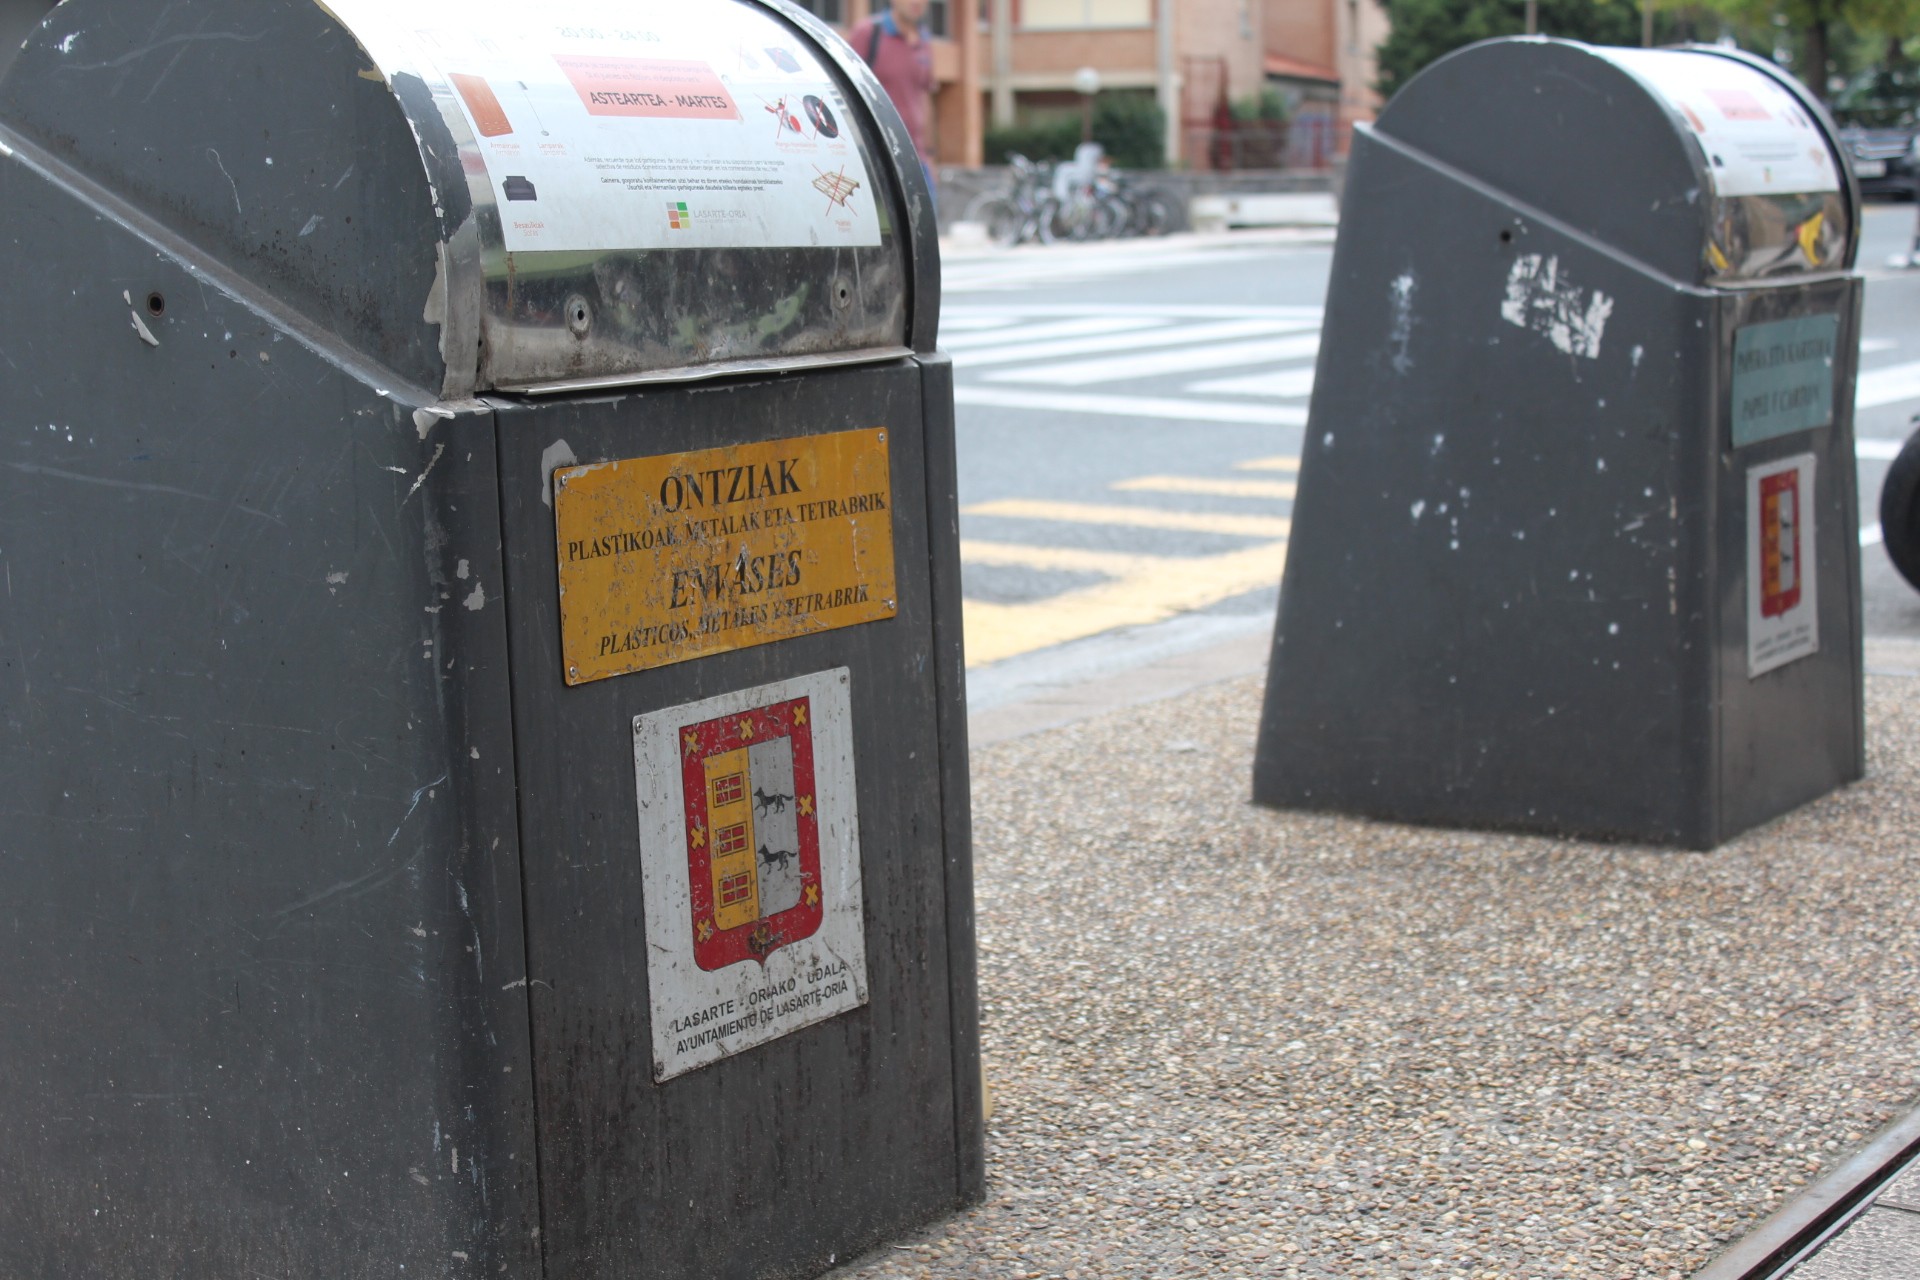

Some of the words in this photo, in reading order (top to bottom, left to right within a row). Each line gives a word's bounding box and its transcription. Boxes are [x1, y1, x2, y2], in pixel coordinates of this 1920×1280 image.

[590, 92, 666, 107] ASTEARTEA
[676, 95, 728, 109] MARTES
[660, 457, 801, 514] ONTZIAK
[685, 511, 761, 540] METALAK
[764, 507, 794, 530] ETA
[798, 491, 887, 524] TETRABRIK
[669, 550, 803, 610] ENVASES
[698, 602, 769, 637] METALES
[771, 600, 783, 619] Y
[785, 583, 870, 617] TETRABRIK
[674, 999, 735, 1033] LASARTE
[749, 978, 797, 1006] ORIAKO
[807, 960, 847, 985] UDALA
[676, 1013, 758, 1056] AYUNTAMIENTO
[760, 1007, 774, 1025] DE
[777, 980, 848, 1017] LASARTE-ORIA
